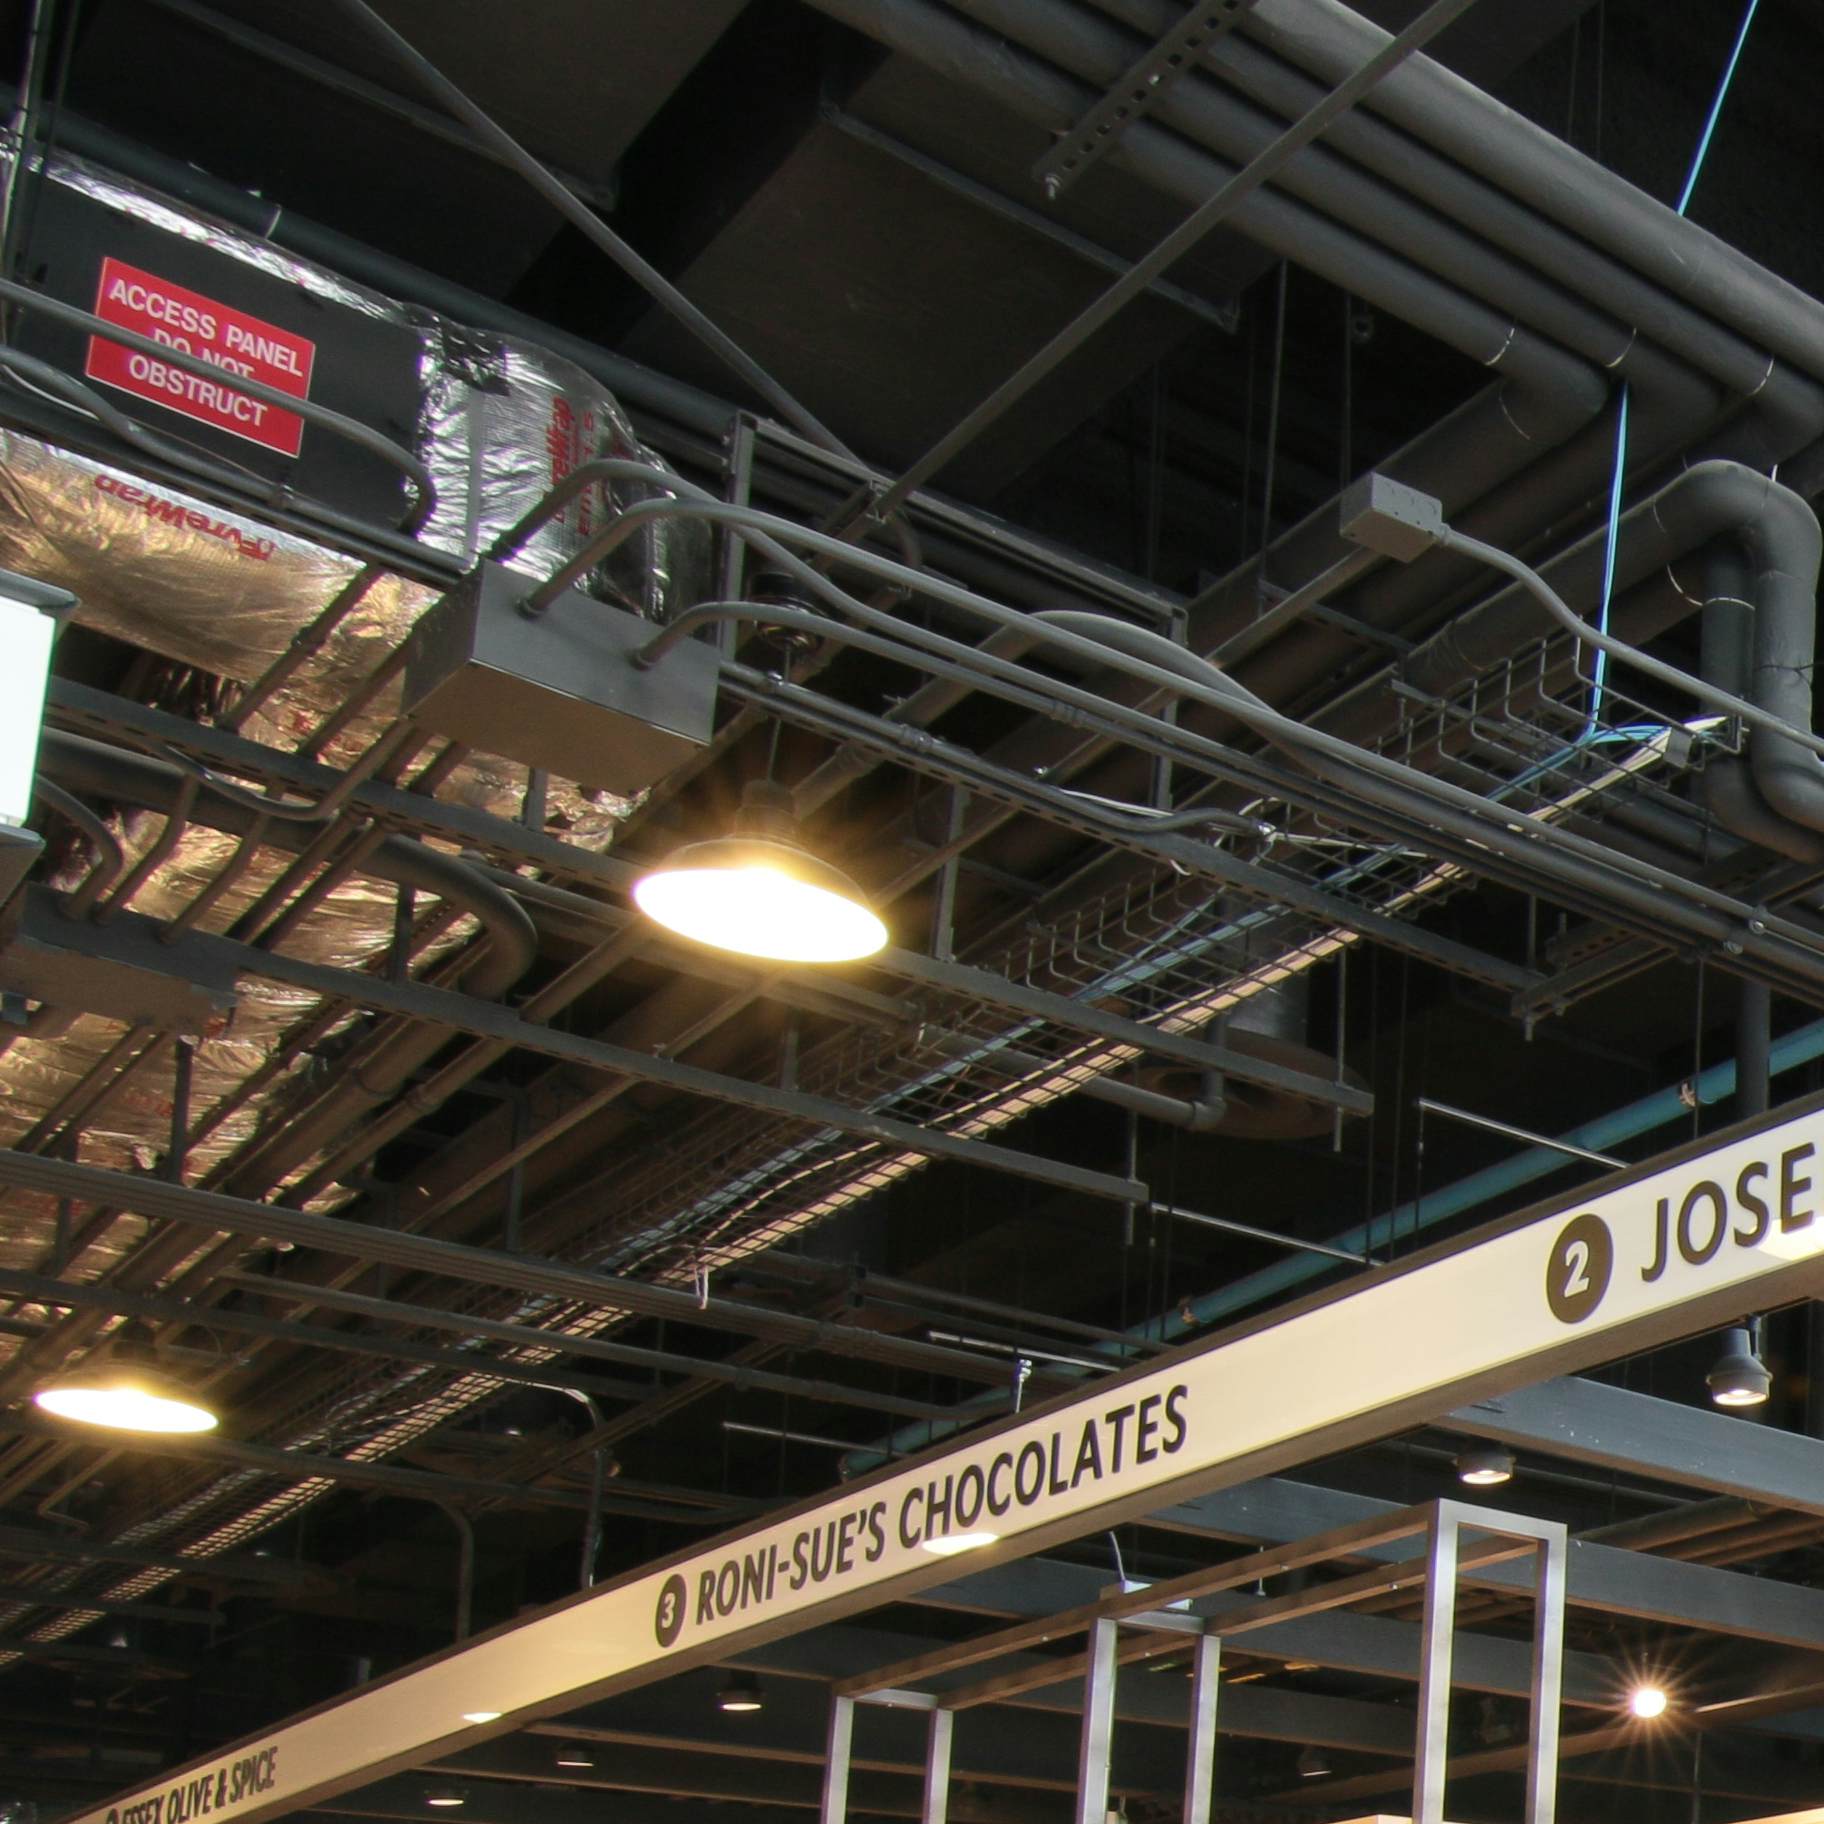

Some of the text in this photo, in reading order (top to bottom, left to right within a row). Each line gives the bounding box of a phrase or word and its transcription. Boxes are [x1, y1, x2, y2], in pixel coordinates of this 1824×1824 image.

[108, 278, 304, 378] ACCESS PANEL
[128, 355, 268, 427] OBSTRUCT
[1563, 1249, 1591, 1297] 2
[661, 1384, 1190, 1627] 3 RONI-SUE'S CHOCOLATES
[214, 1768, 228, 1809] &
[229, 1746, 279, 1803] SPICE
